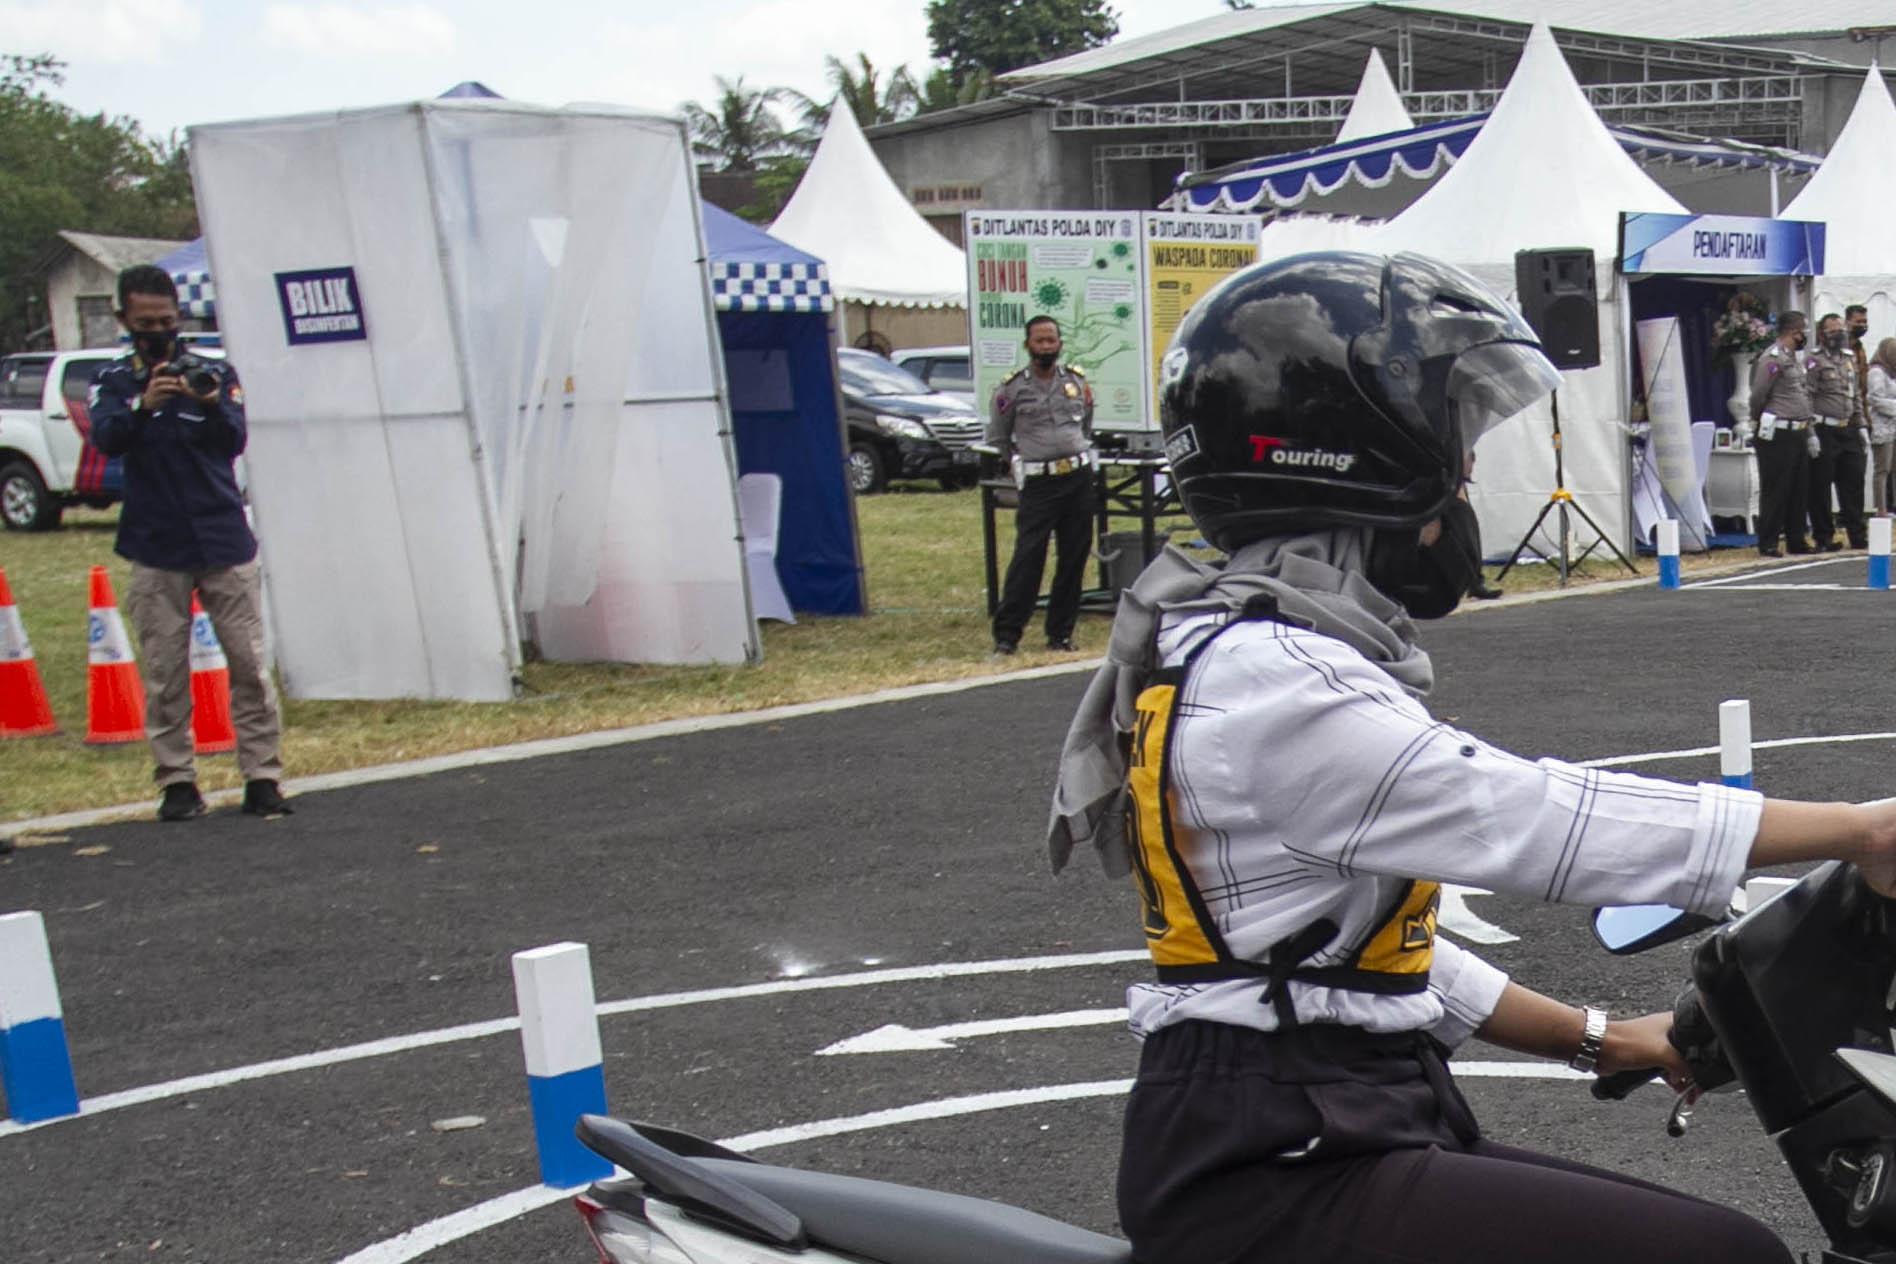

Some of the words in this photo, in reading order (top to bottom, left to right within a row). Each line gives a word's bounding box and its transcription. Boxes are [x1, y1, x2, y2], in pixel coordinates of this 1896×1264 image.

[983, 219, 1048, 236] DITLANTAS
[1051, 219, 1092, 236] POLDA
[1095, 220, 1116, 237] DIY
[1159, 221, 1201, 238] DITLANTAS
[1203, 222, 1228, 239] POLDA
[1153, 246, 1206, 268] WASPADA
[1693, 231, 1767, 259] PENDAFTARAN
[977, 259, 1029, 293] BUNUH
[286, 278, 354, 316] BILIK
[979, 302, 1026, 329] CORONA
[1249, 434, 1354, 472] Touring
